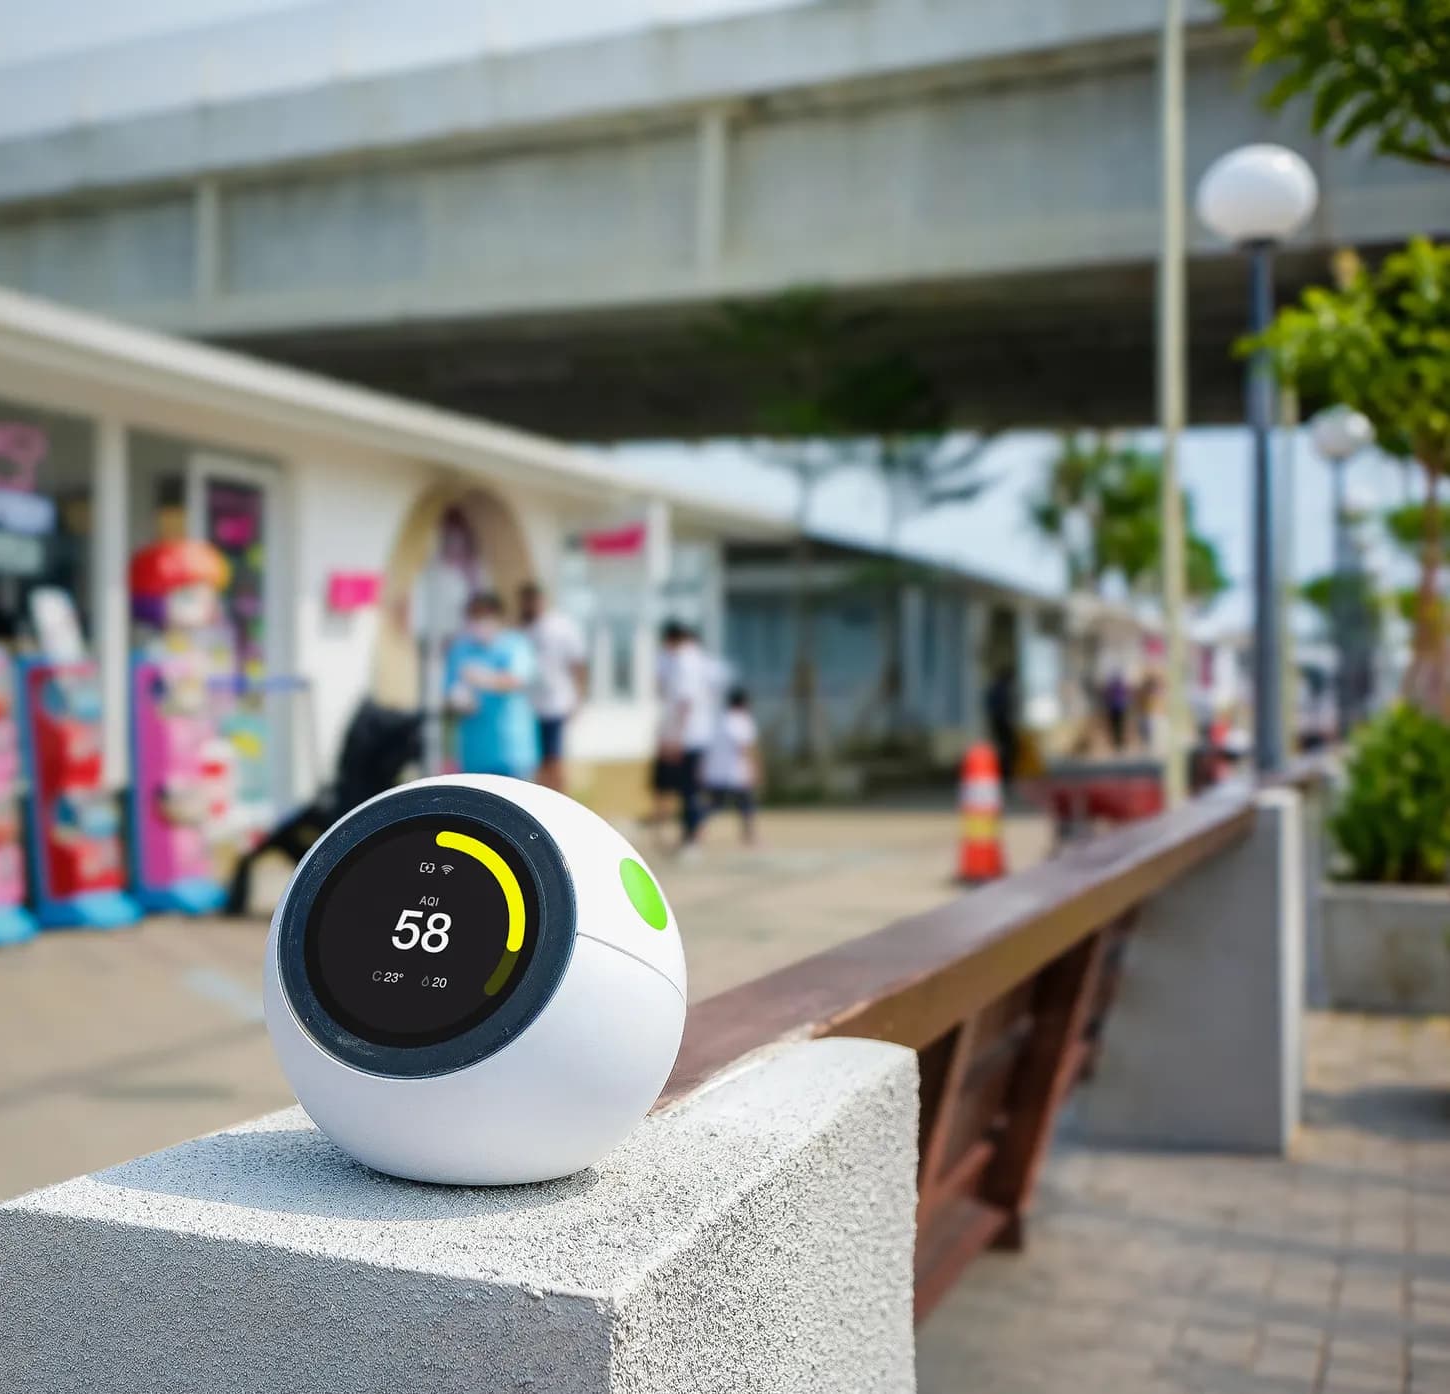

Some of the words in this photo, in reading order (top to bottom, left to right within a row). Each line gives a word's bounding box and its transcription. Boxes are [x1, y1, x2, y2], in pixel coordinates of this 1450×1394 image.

[419, 896, 439, 907] AQI
[392, 909, 452, 953] 58
[432, 977, 447, 988] 20
